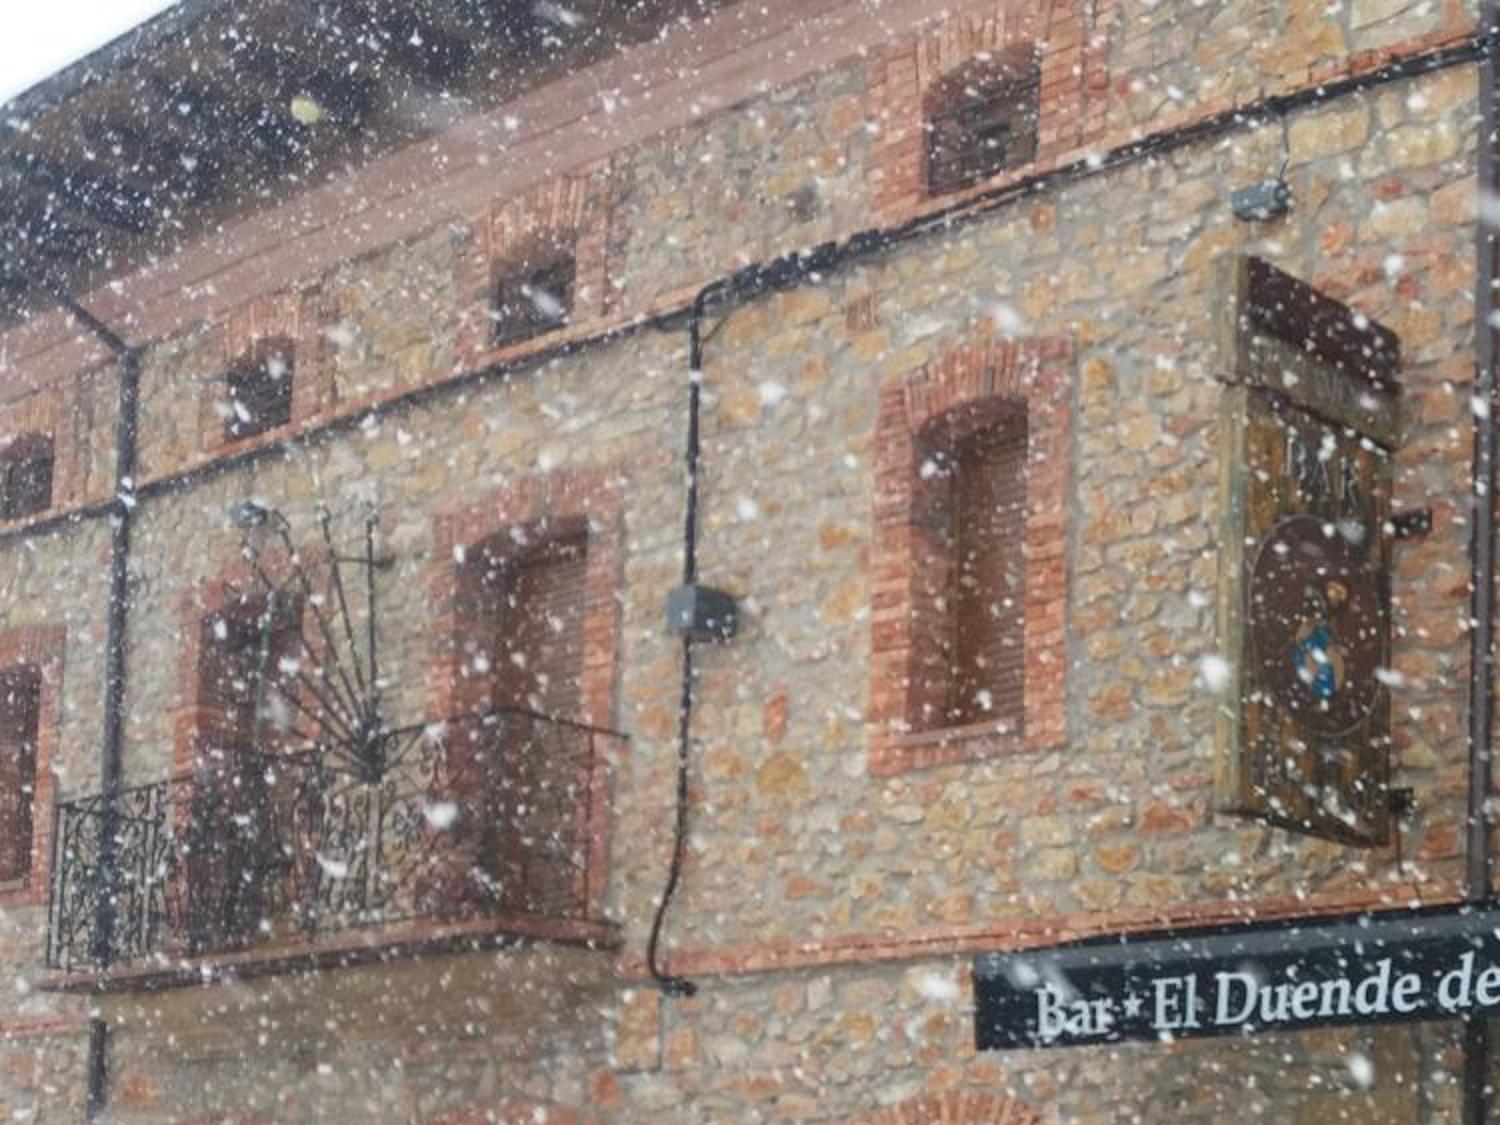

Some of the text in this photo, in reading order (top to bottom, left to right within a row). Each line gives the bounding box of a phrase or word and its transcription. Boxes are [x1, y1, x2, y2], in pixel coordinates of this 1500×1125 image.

[1036, 981, 1113, 1038] Bar
[1150, 972, 1200, 1030] El
[1214, 959, 1423, 1026] Duende
